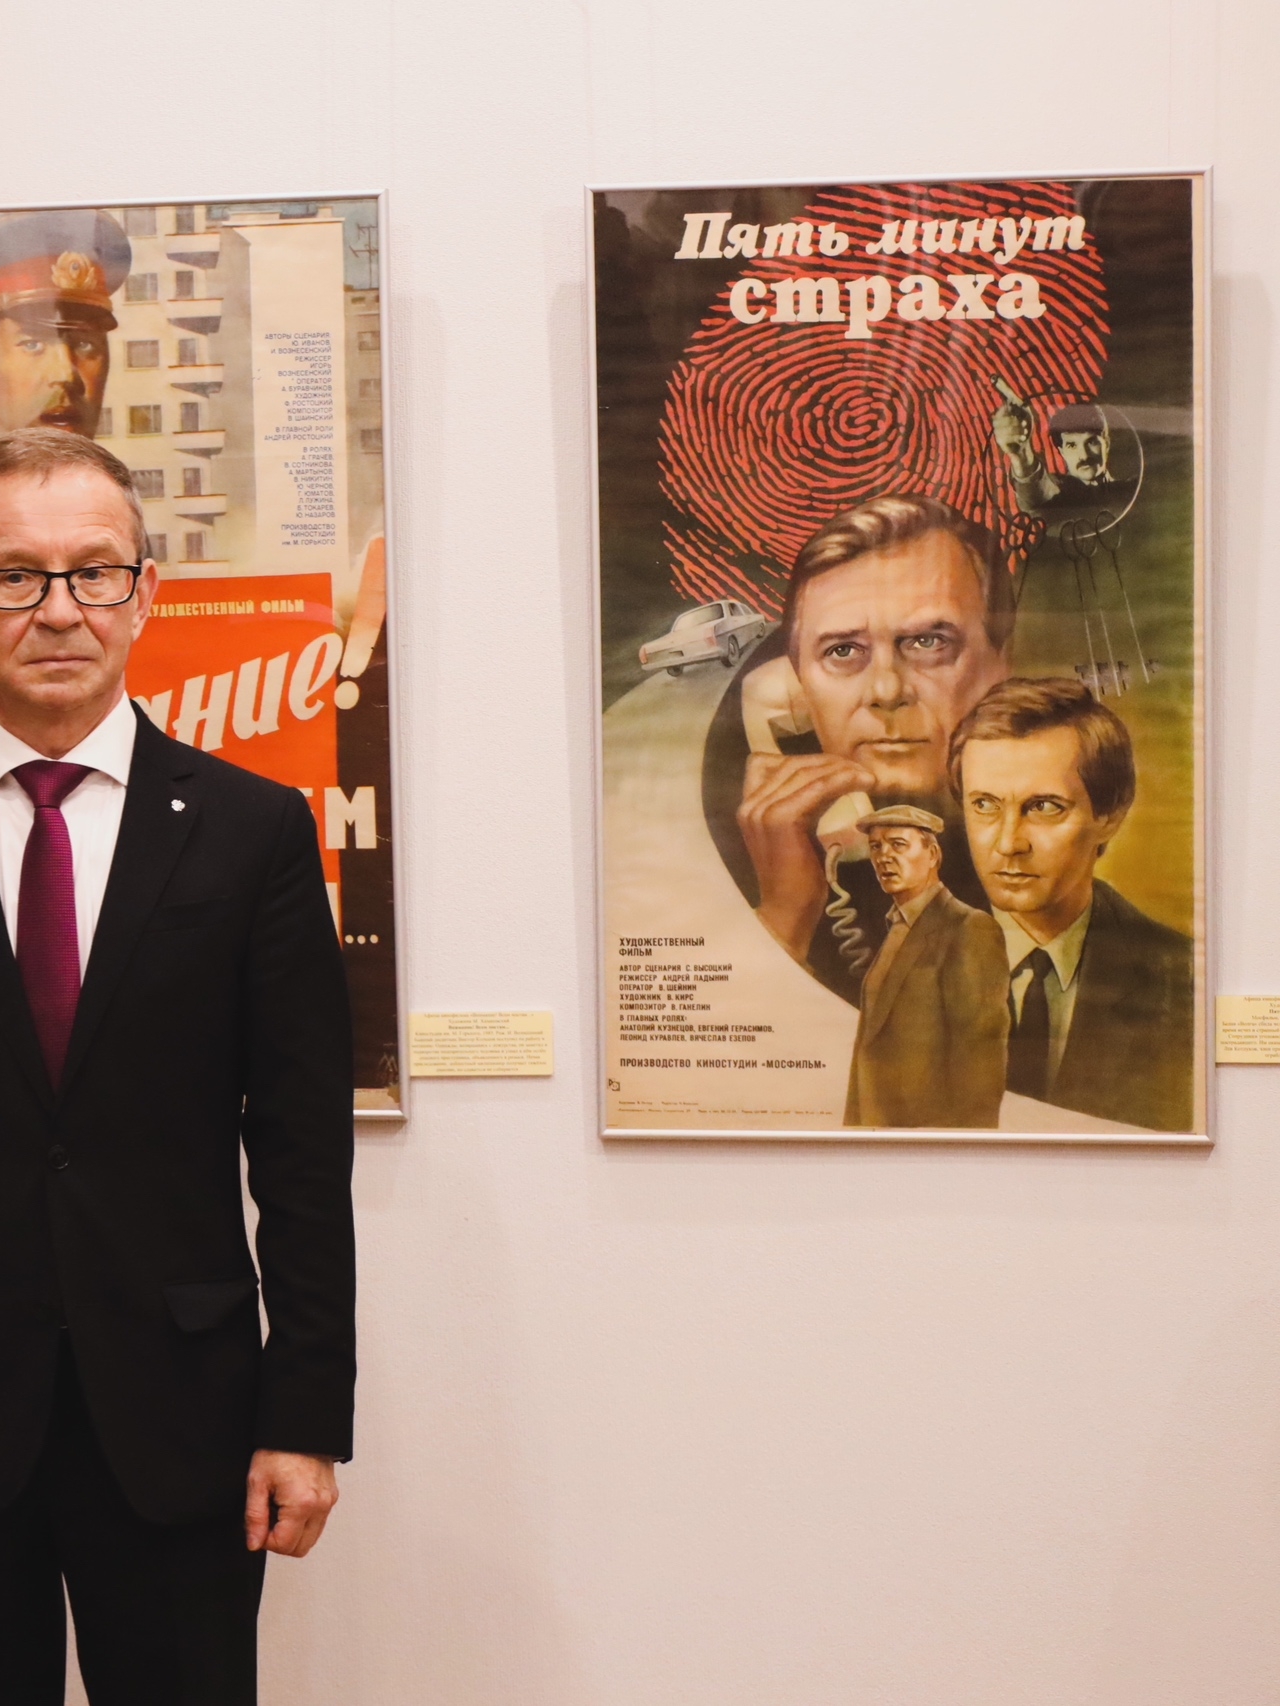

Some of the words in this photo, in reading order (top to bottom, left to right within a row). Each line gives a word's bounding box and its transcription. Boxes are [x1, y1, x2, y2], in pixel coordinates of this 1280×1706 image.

[674, 212, 849, 259] Пять
[865, 215, 1086, 265] минут
[729, 272, 1047, 339] страха
[278, 346, 332, 354] ВОЗНЕСЕНСКИЙ
[277, 369, 332, 377] ВОЗНЕСЕНСКИЙ
[292, 398, 334, 406] РОСТОЦКИЙ
[294, 414, 334, 422] ШАИНСКИЙ
[264, 433, 291, 441] АНДРЕЙ
[261, 599, 305, 614] ФИЛЬМ
[619, 936, 705, 948] ХУДОЖЕСТВЕННЫЙ
[619, 948, 653, 957] ФИЛЬМ
[619, 964, 642, 972] АВТОР
[644, 964, 682, 972] СЦЕНАРИЯ
[693, 963, 733, 972] ВЫСОЦКИЙ
[619, 974, 658, 982] РЕЖИССЕР
[662, 973, 690, 982] АНДРЕЙ
[619, 984, 654, 992] ОПЕРАТОР
[658, 984, 666, 992] В.
[666, 983, 697, 992] ШЕЙНИН
[619, 1003, 667, 1011] КОМПОЗИТОР
[657, 1025, 696, 1033] КУЗНЕЦОВ,
[698, 1024, 729, 1032] ЕВГЕНИЙ
[731, 1025, 775, 1033] ГЕРАСИМОВ,
[620, 1034, 647, 1042] ЛЕОНИД
[649, 1034, 688, 1042] КУРАВЛЕВ,
[619, 1058, 691, 1069] ПРОИЗВОДСТВО
[696, 1059, 758, 1070] КИНОСТУДИИ
[761, 1059, 827, 1070] «МОСФИЛЬМ»
